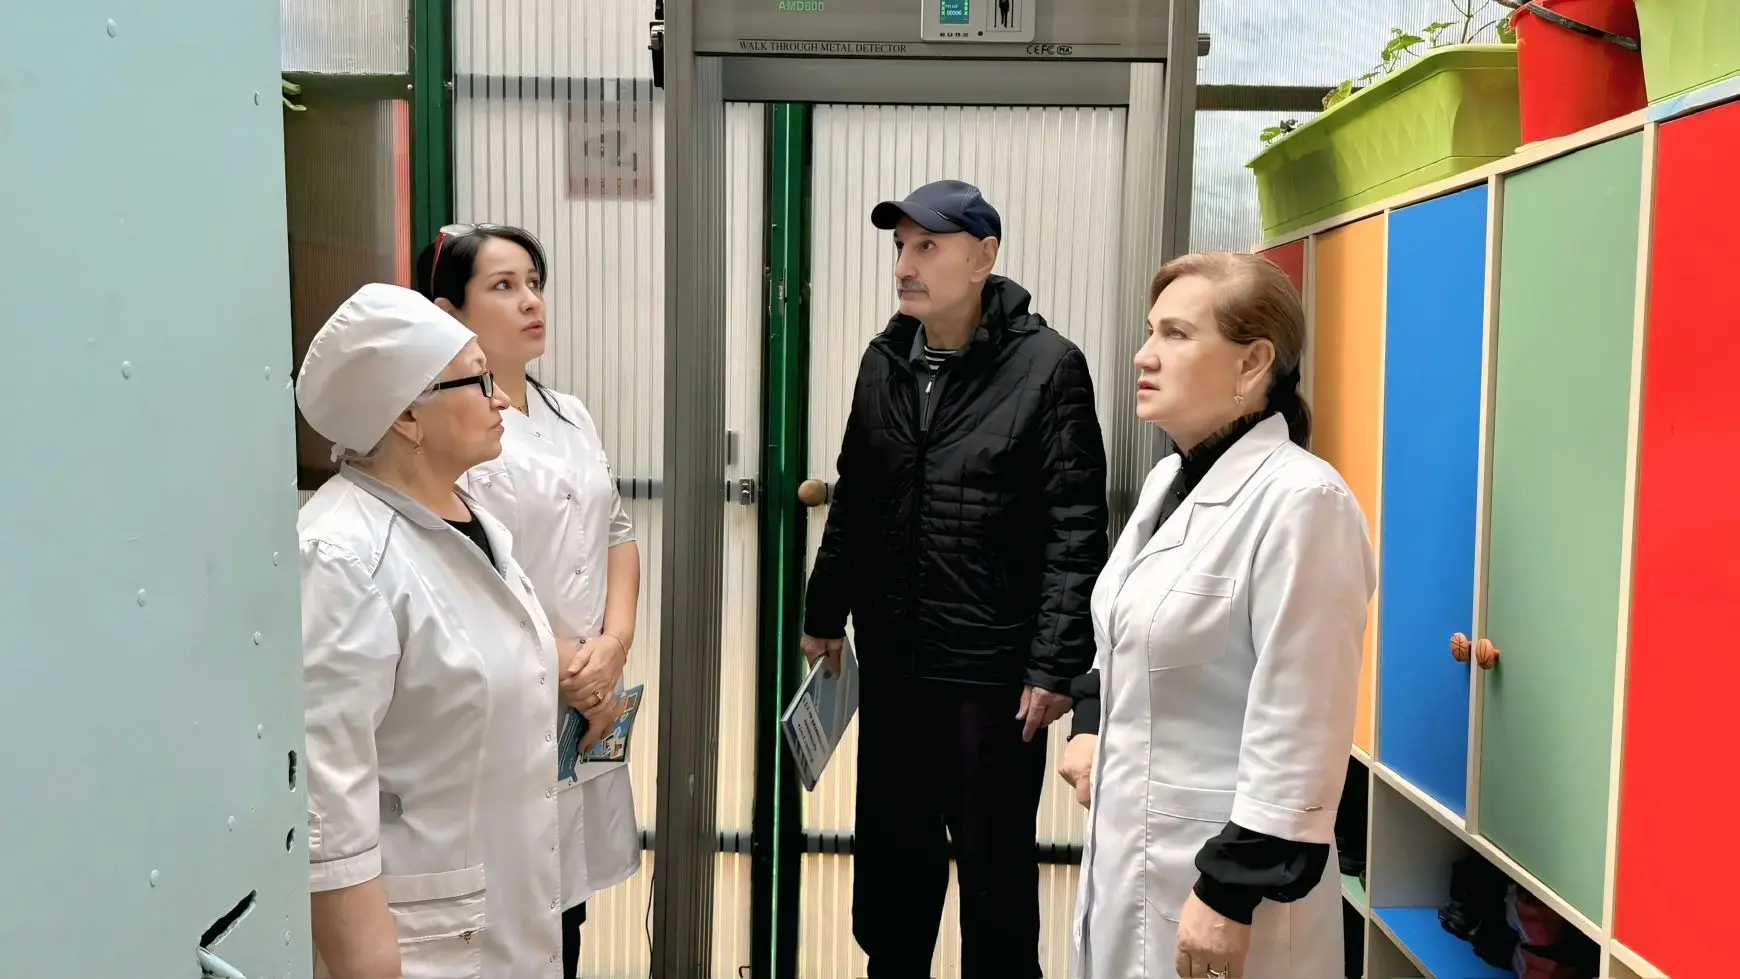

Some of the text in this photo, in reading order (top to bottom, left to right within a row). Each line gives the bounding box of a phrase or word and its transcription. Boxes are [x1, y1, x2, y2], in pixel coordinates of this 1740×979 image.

[779, 1, 824, 11] AMD600
[740, 41, 906, 53] WALK THROUGH METAL DETECTOR
